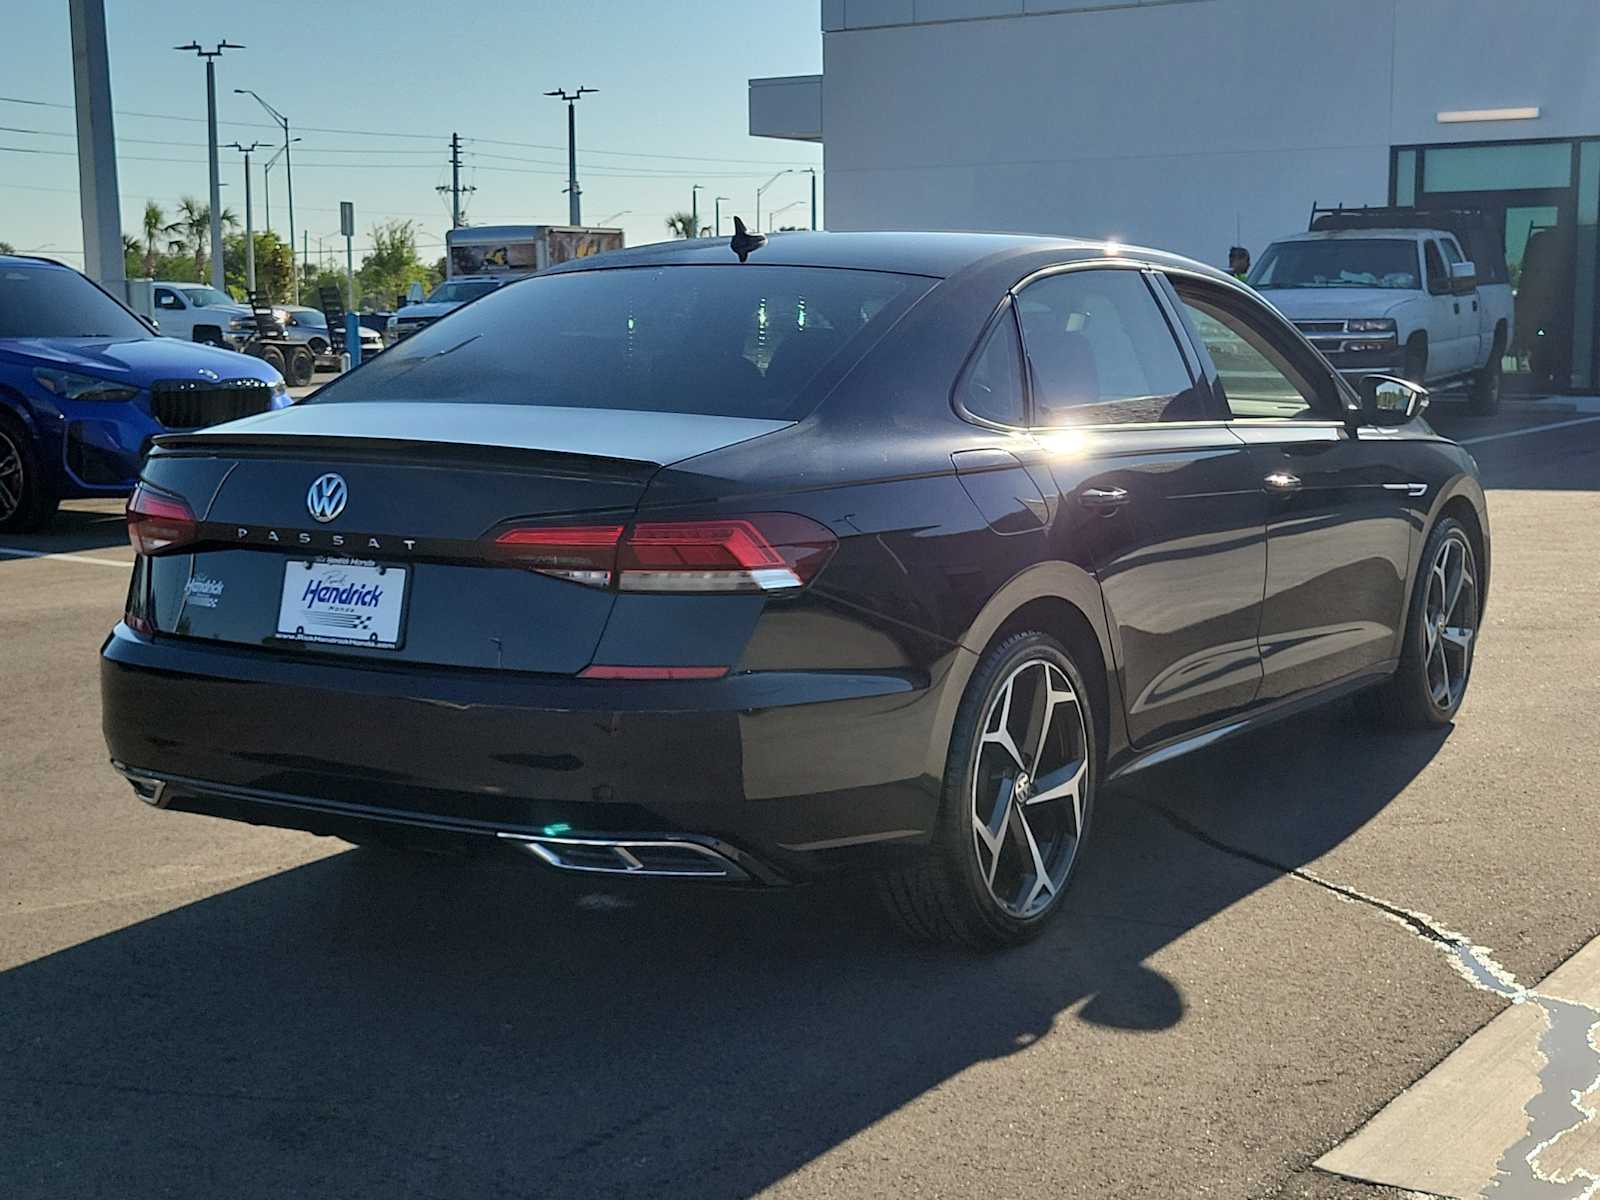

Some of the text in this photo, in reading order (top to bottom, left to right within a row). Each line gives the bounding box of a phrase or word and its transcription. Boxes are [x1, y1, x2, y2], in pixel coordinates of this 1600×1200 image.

[308, 473, 348, 522] VW
[237, 527, 416, 551] PASSAT
[302, 579, 384, 609] Hendrick
